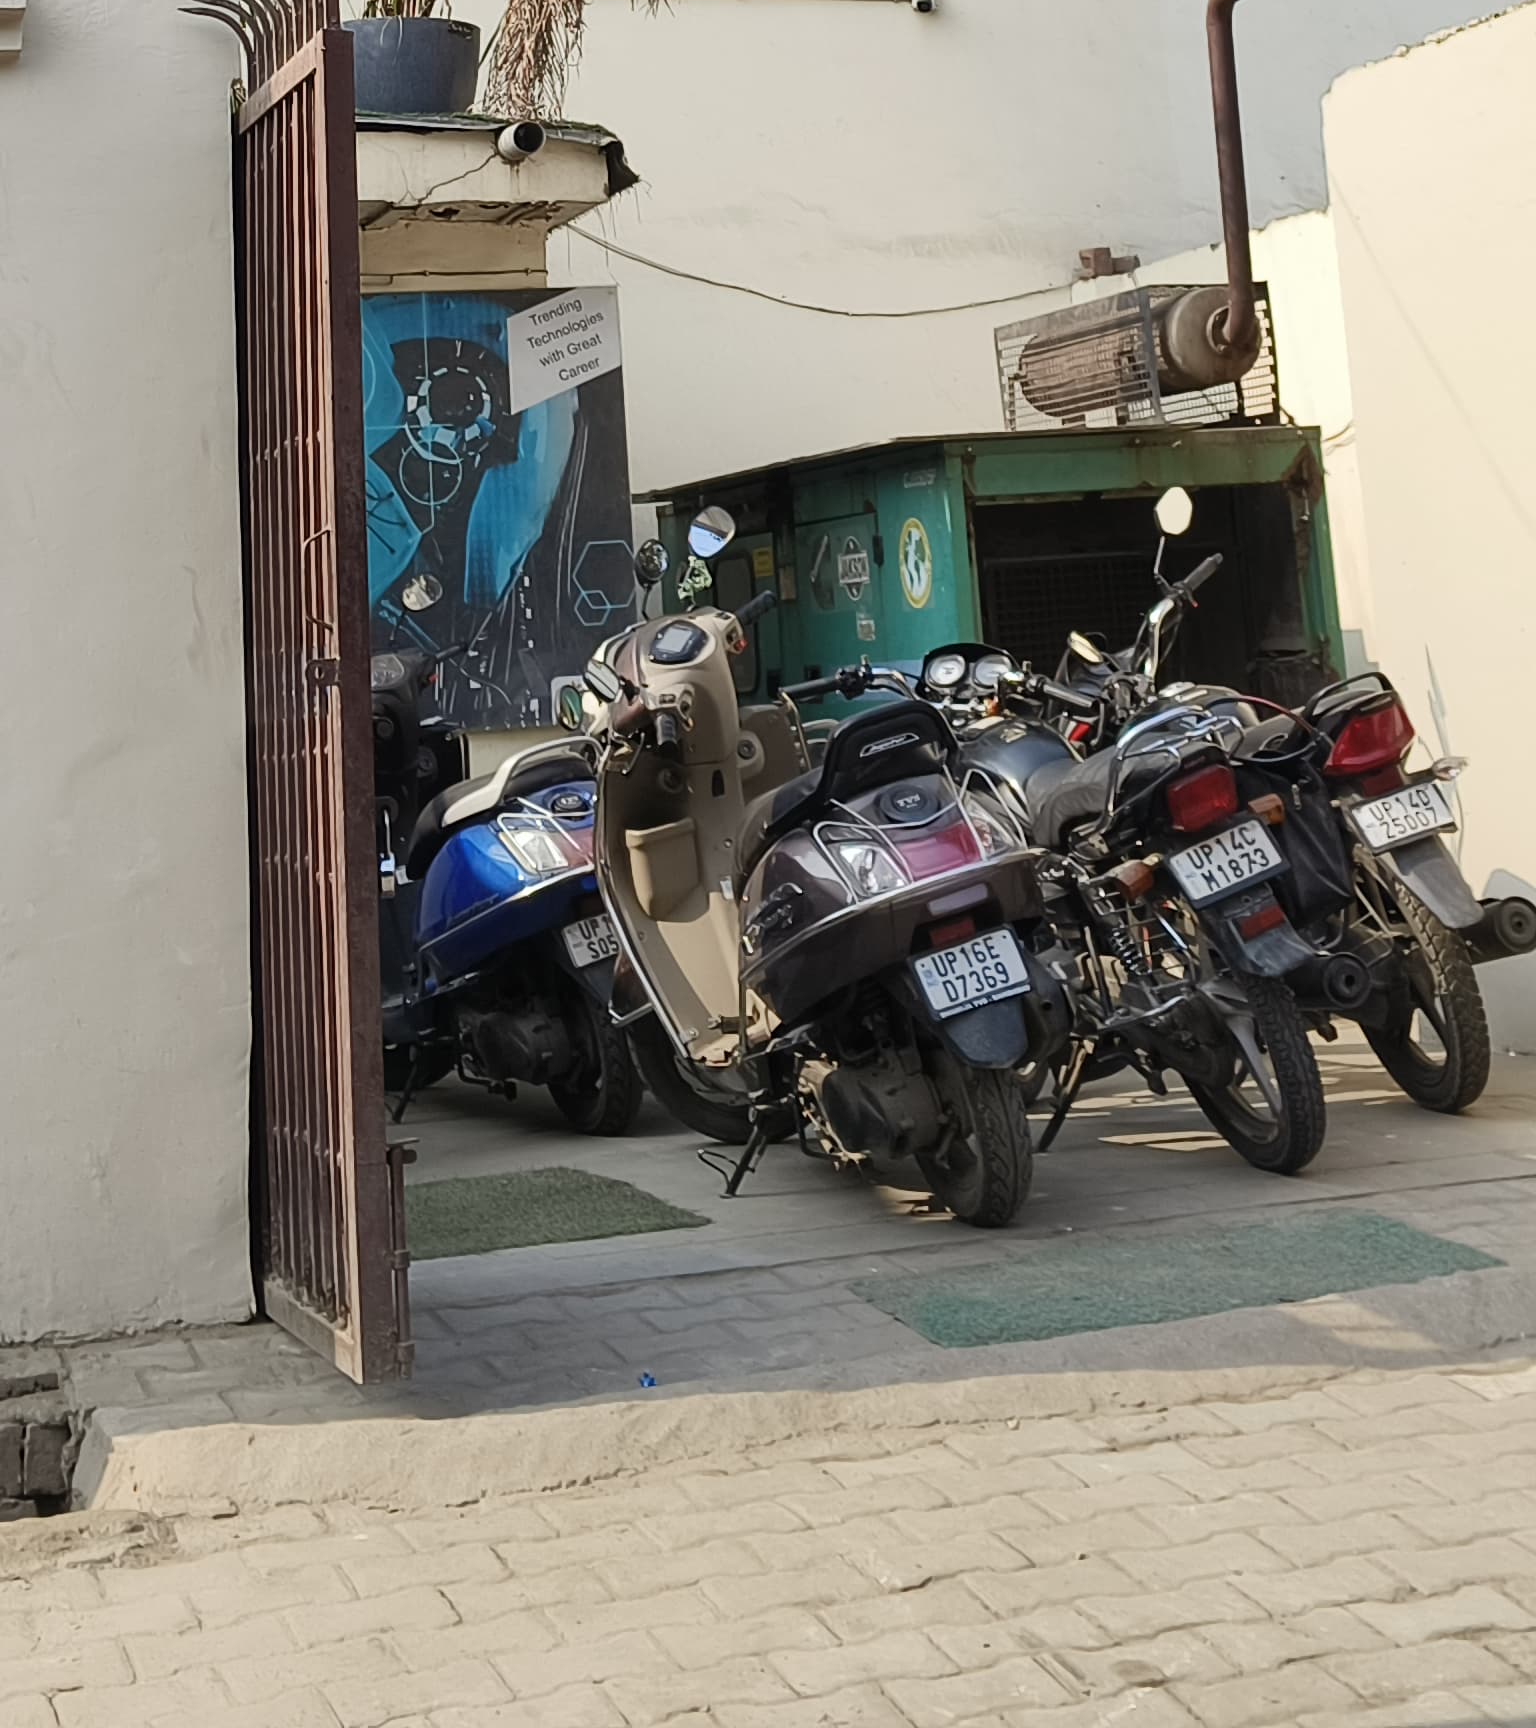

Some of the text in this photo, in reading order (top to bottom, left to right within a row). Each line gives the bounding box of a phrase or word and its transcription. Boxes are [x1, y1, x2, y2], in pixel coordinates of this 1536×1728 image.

[528, 299, 582, 326] Trending
[527, 312, 604, 349] Technologies
[539, 333, 602, 367] with Great
[558, 357, 600, 381] Career
[942, 962, 1009, 1003] D7369
